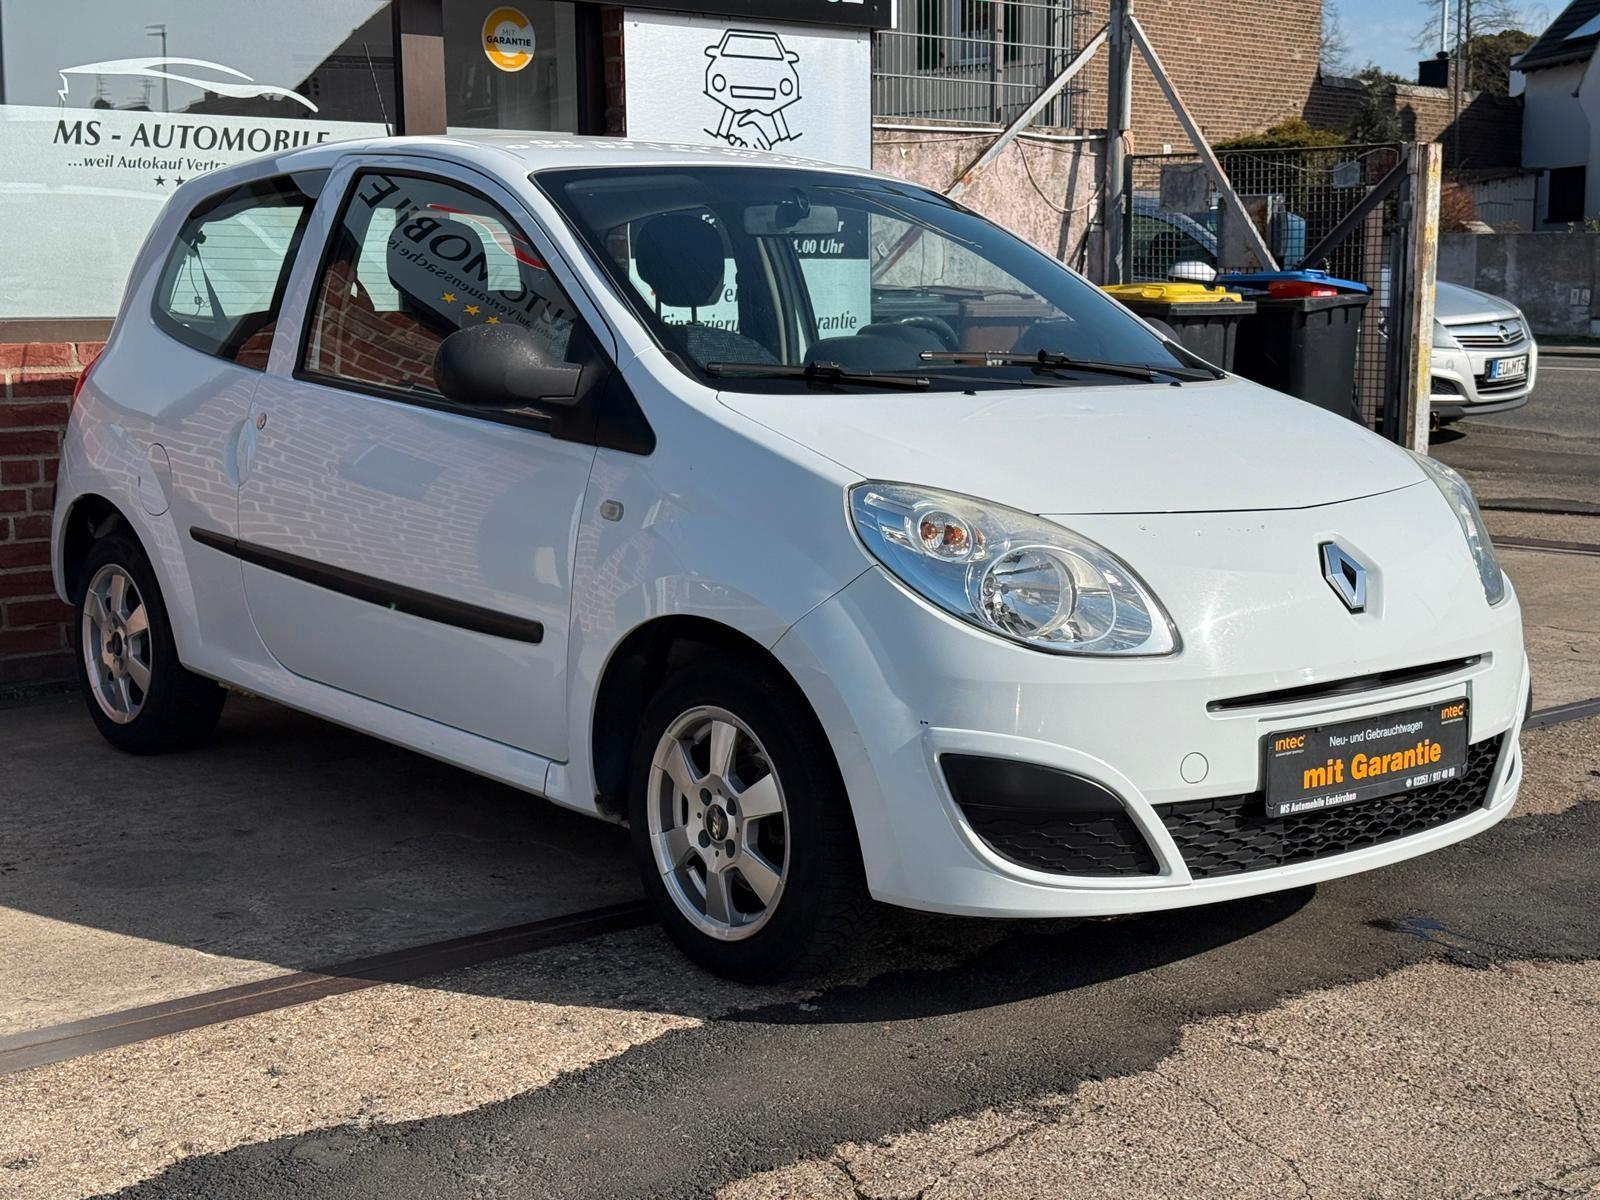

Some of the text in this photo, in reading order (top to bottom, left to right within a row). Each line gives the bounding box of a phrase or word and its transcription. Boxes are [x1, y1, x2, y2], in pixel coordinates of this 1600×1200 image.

[502, 28, 516, 36] MIT
[487, 35, 532, 46] GARANTIE
[53, 119, 102, 146] MS
[117, 156, 184, 170] Autokauf
[820, 239, 844, 253] Uhr
[1329, 721, 1423, 747] Neu- und Gebrauchtwagen
[1275, 736, 1305, 751] intec
[1303, 738, 1442, 789] mit Garantie
[1291, 798, 1325, 813] Automobile
